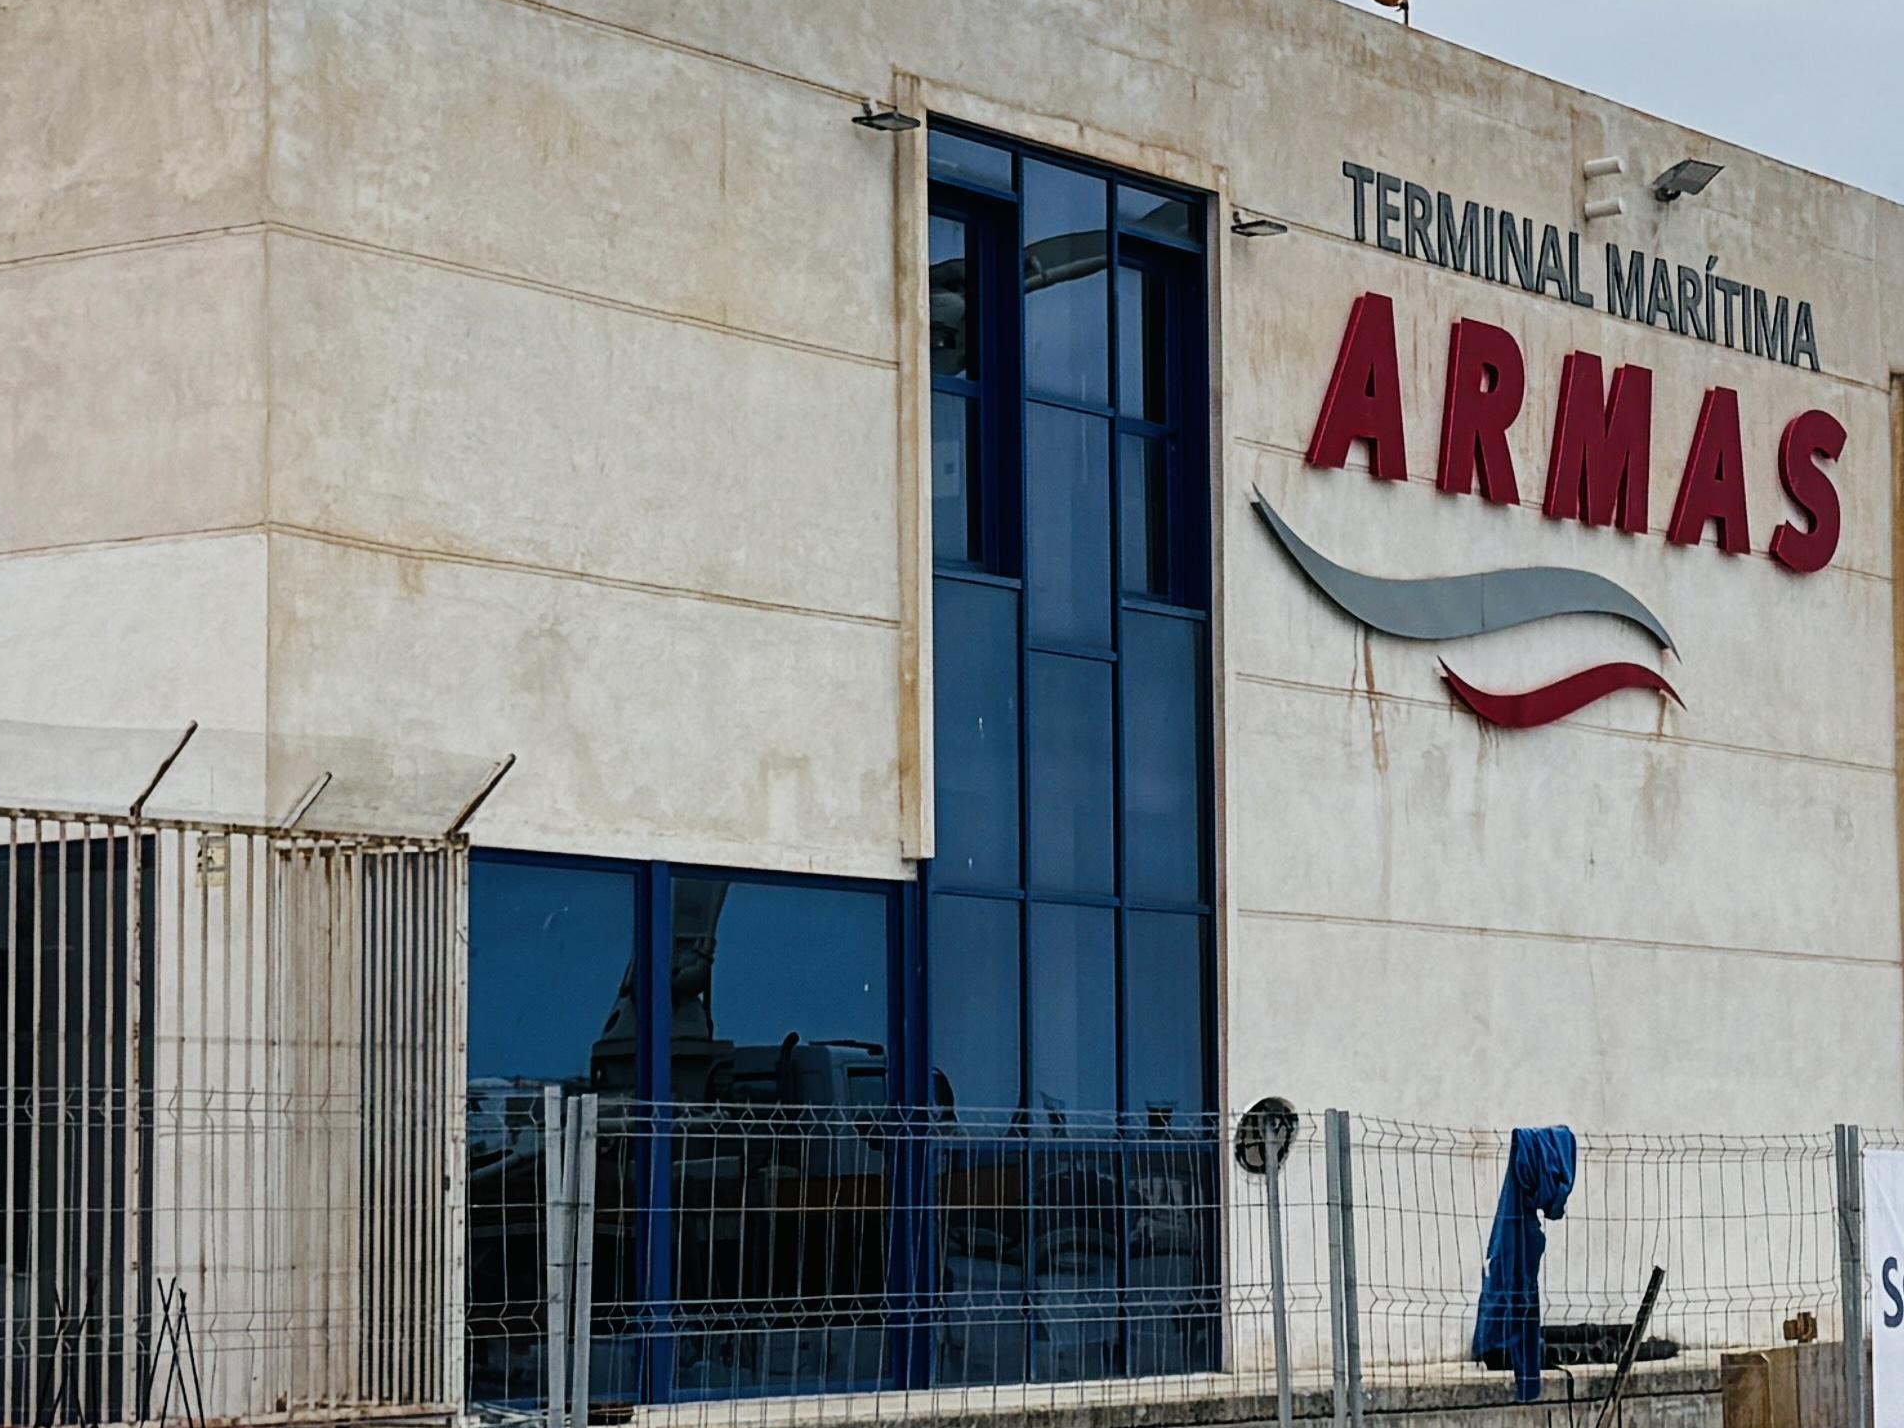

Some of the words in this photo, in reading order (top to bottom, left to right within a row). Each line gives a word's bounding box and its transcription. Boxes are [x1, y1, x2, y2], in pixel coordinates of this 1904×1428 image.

[1342, 160, 1594, 309] TERMINAL
[1605, 242, 1821, 373] MARÍTIMA
[1304, 290, 1849, 574] ARMAS
